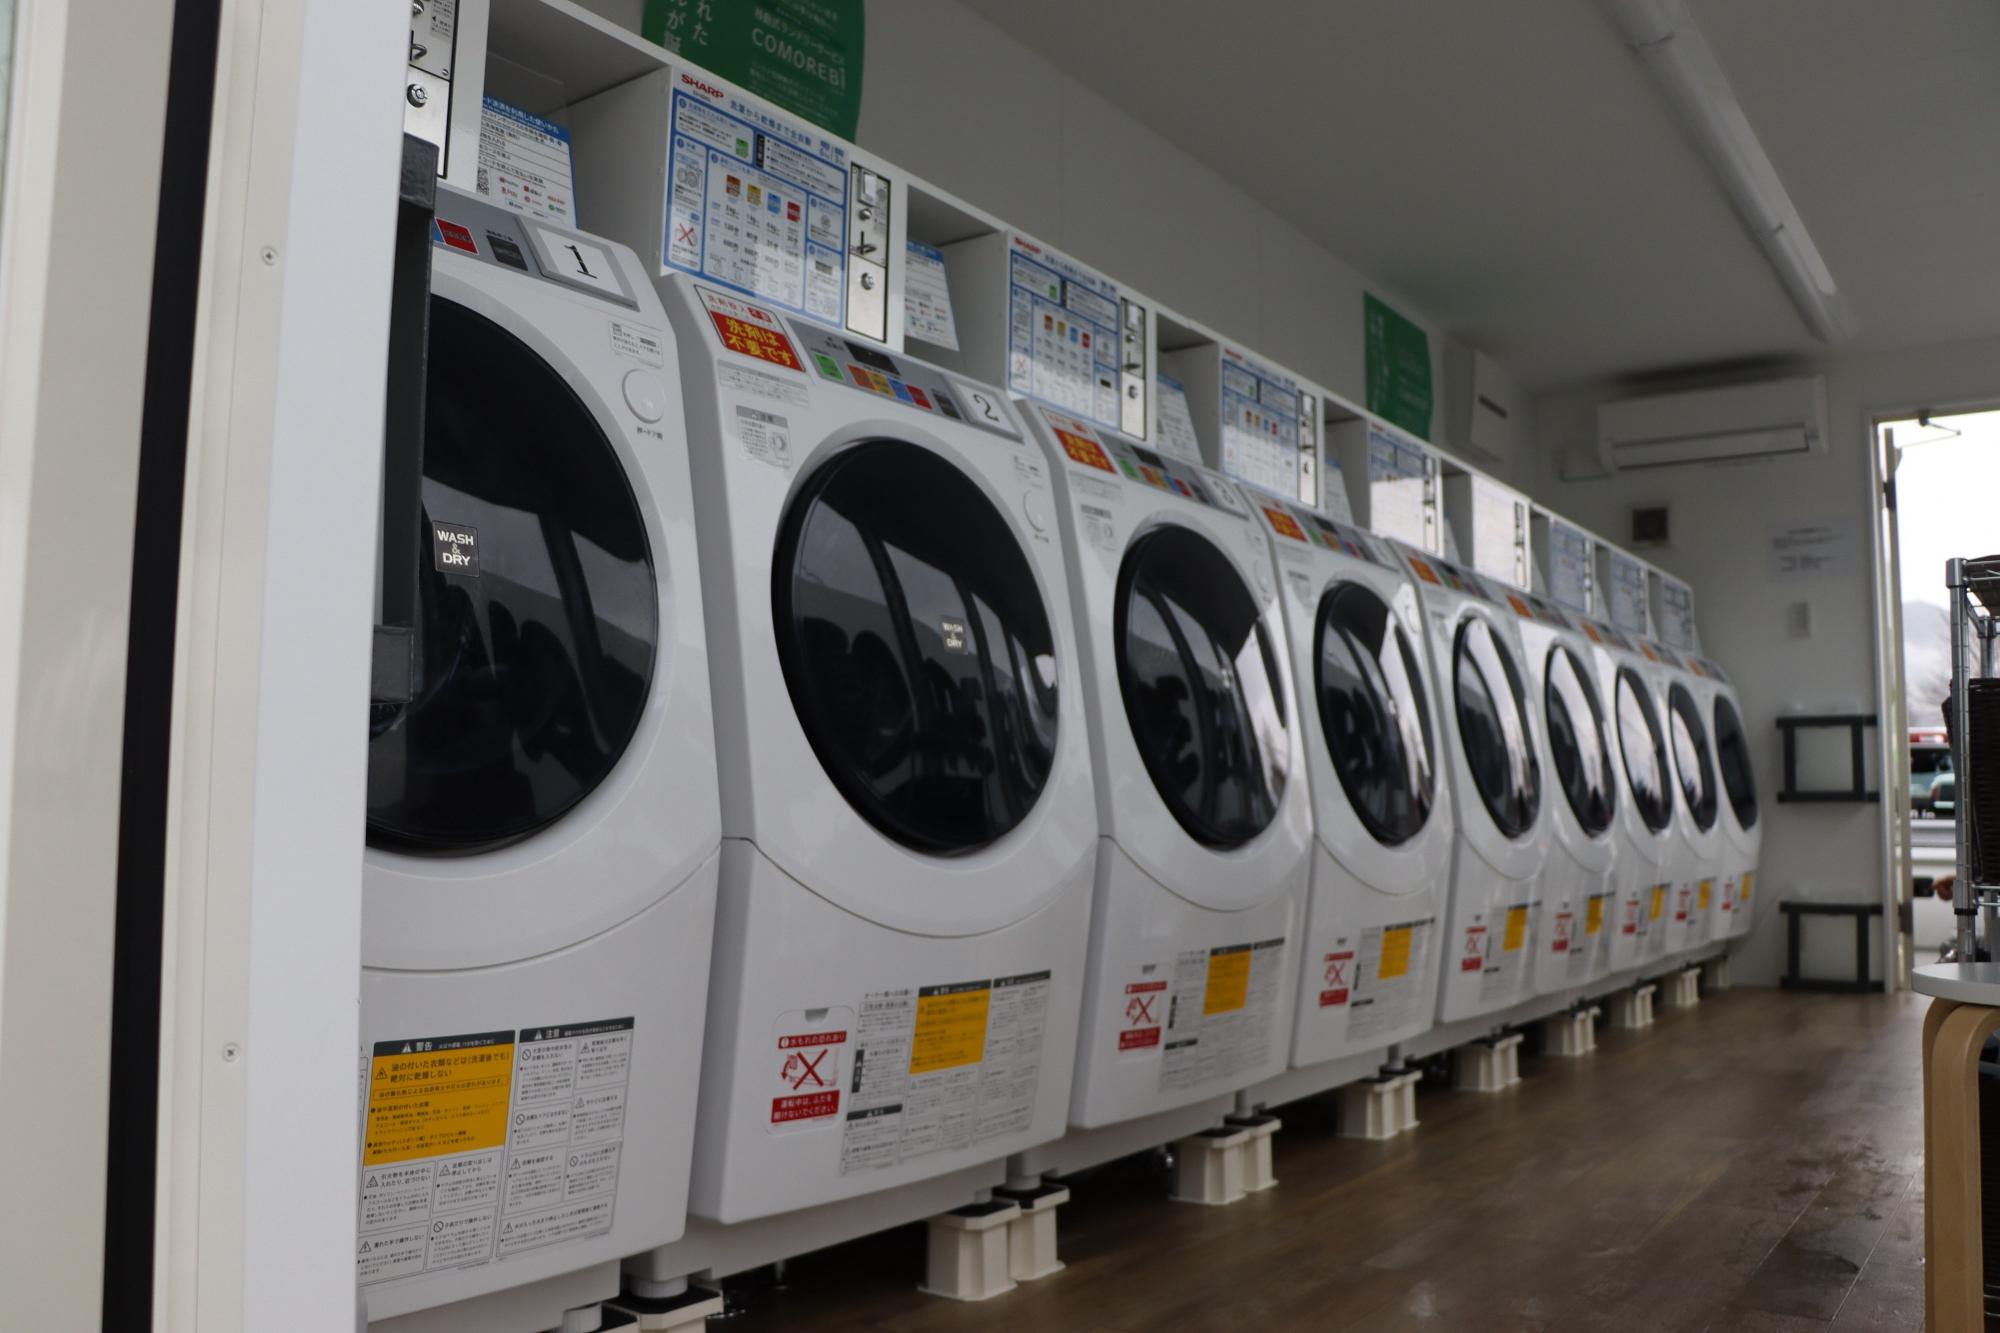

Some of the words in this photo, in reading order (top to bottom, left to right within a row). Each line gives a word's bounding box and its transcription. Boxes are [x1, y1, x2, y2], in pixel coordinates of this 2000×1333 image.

[681, 74, 724, 98] SHARP
[564, 244, 598, 279] 1
[727, 317, 781, 347] 洗剤は
[726, 332, 793, 366] 不要です
[973, 394, 1000, 422] 2
[437, 530, 474, 546] WASH
[442, 552, 470, 566] DRY
[451, 543, 461, 555] &
[942, 622, 963, 633] WASH
[946, 638, 962, 649] DRY
